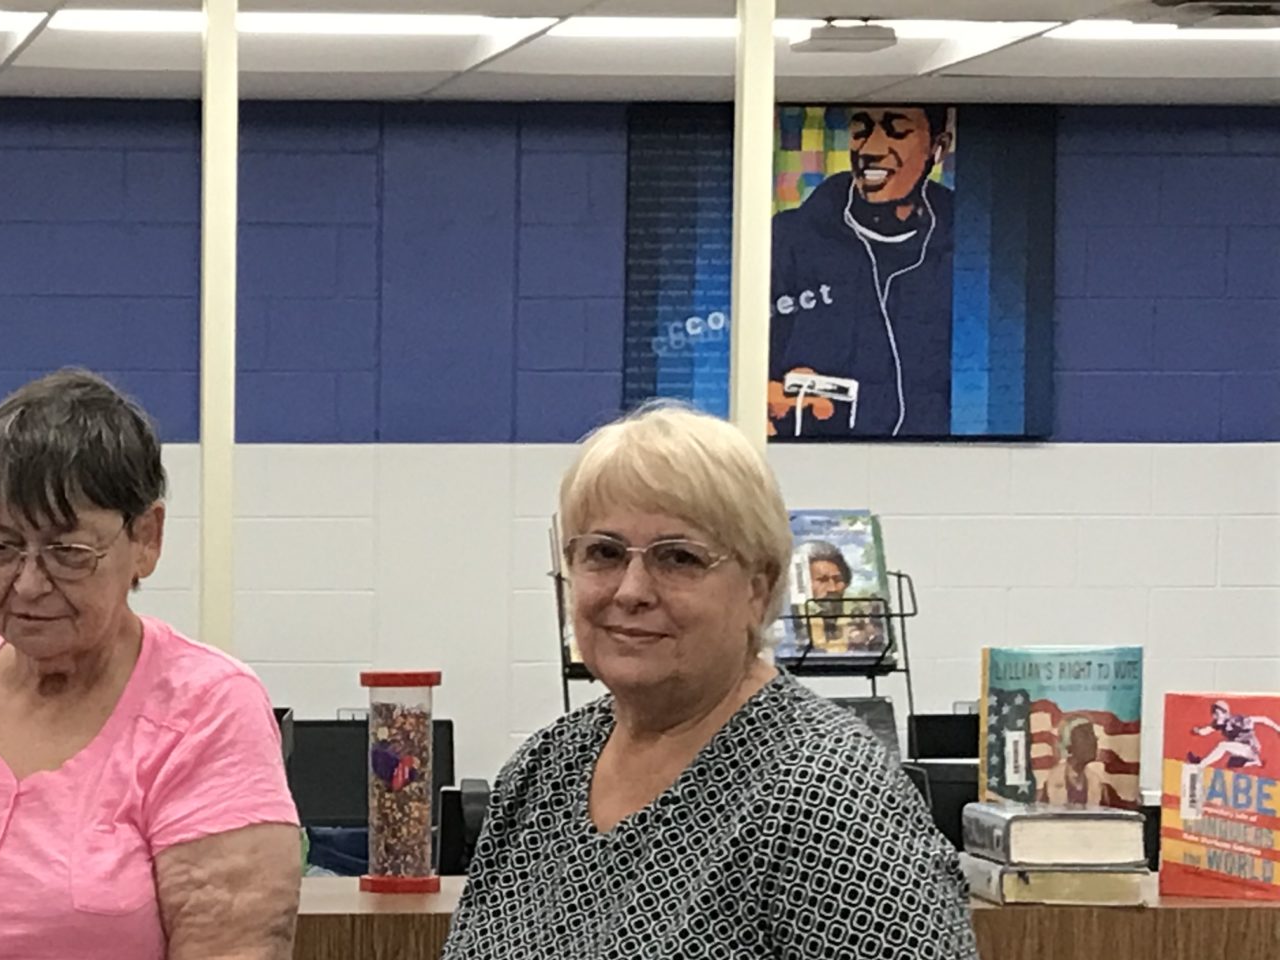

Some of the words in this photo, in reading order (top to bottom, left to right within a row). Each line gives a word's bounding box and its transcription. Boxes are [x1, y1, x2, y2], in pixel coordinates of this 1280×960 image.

[685, 284, 833, 335] coect
[995, 661, 1053, 681] LILLIAN'S
[1058, 660, 1092, 680] RIGHT
[1097, 662, 1111, 680] TO
[1114, 660, 1139, 680] VOTE
[1205, 768, 1277, 815] ABE
